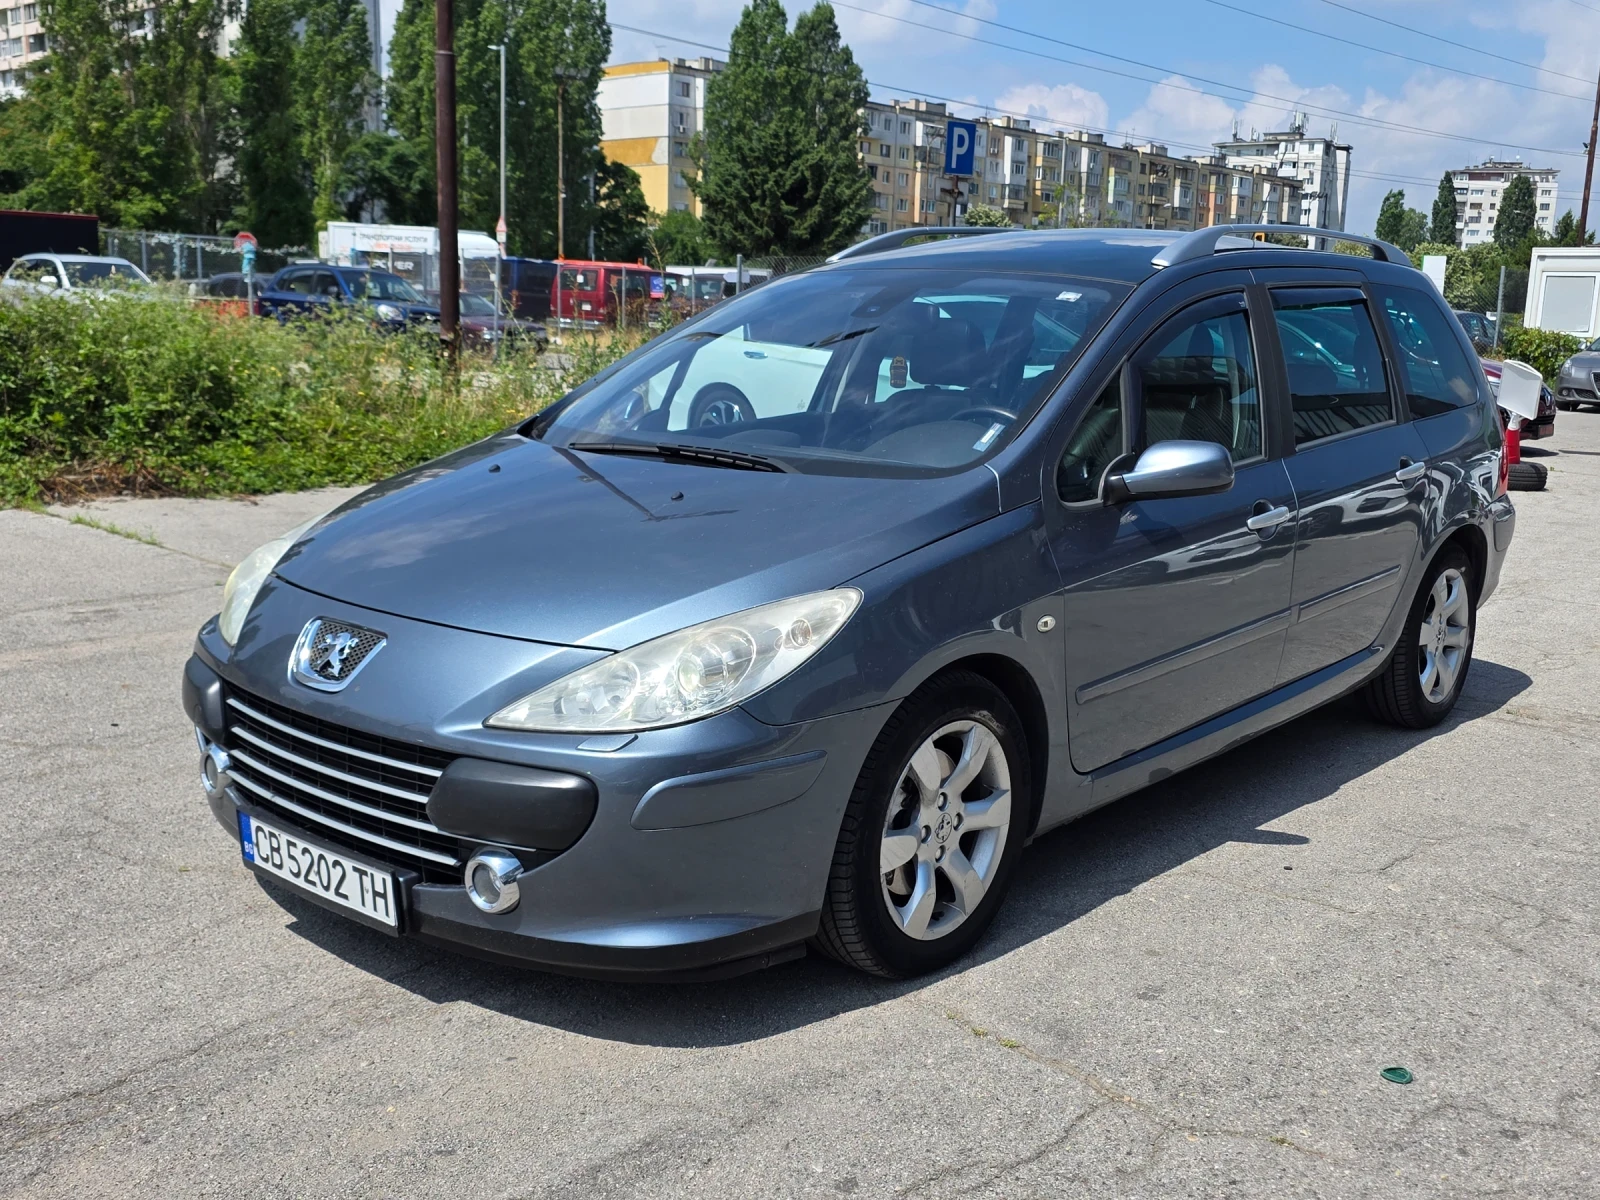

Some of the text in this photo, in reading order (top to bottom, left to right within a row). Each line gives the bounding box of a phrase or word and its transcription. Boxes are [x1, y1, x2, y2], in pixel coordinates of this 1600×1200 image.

[951, 126, 970, 169] P
[243, 840, 254, 855] BG
[255, 825, 390, 918] CB 5202 TH
